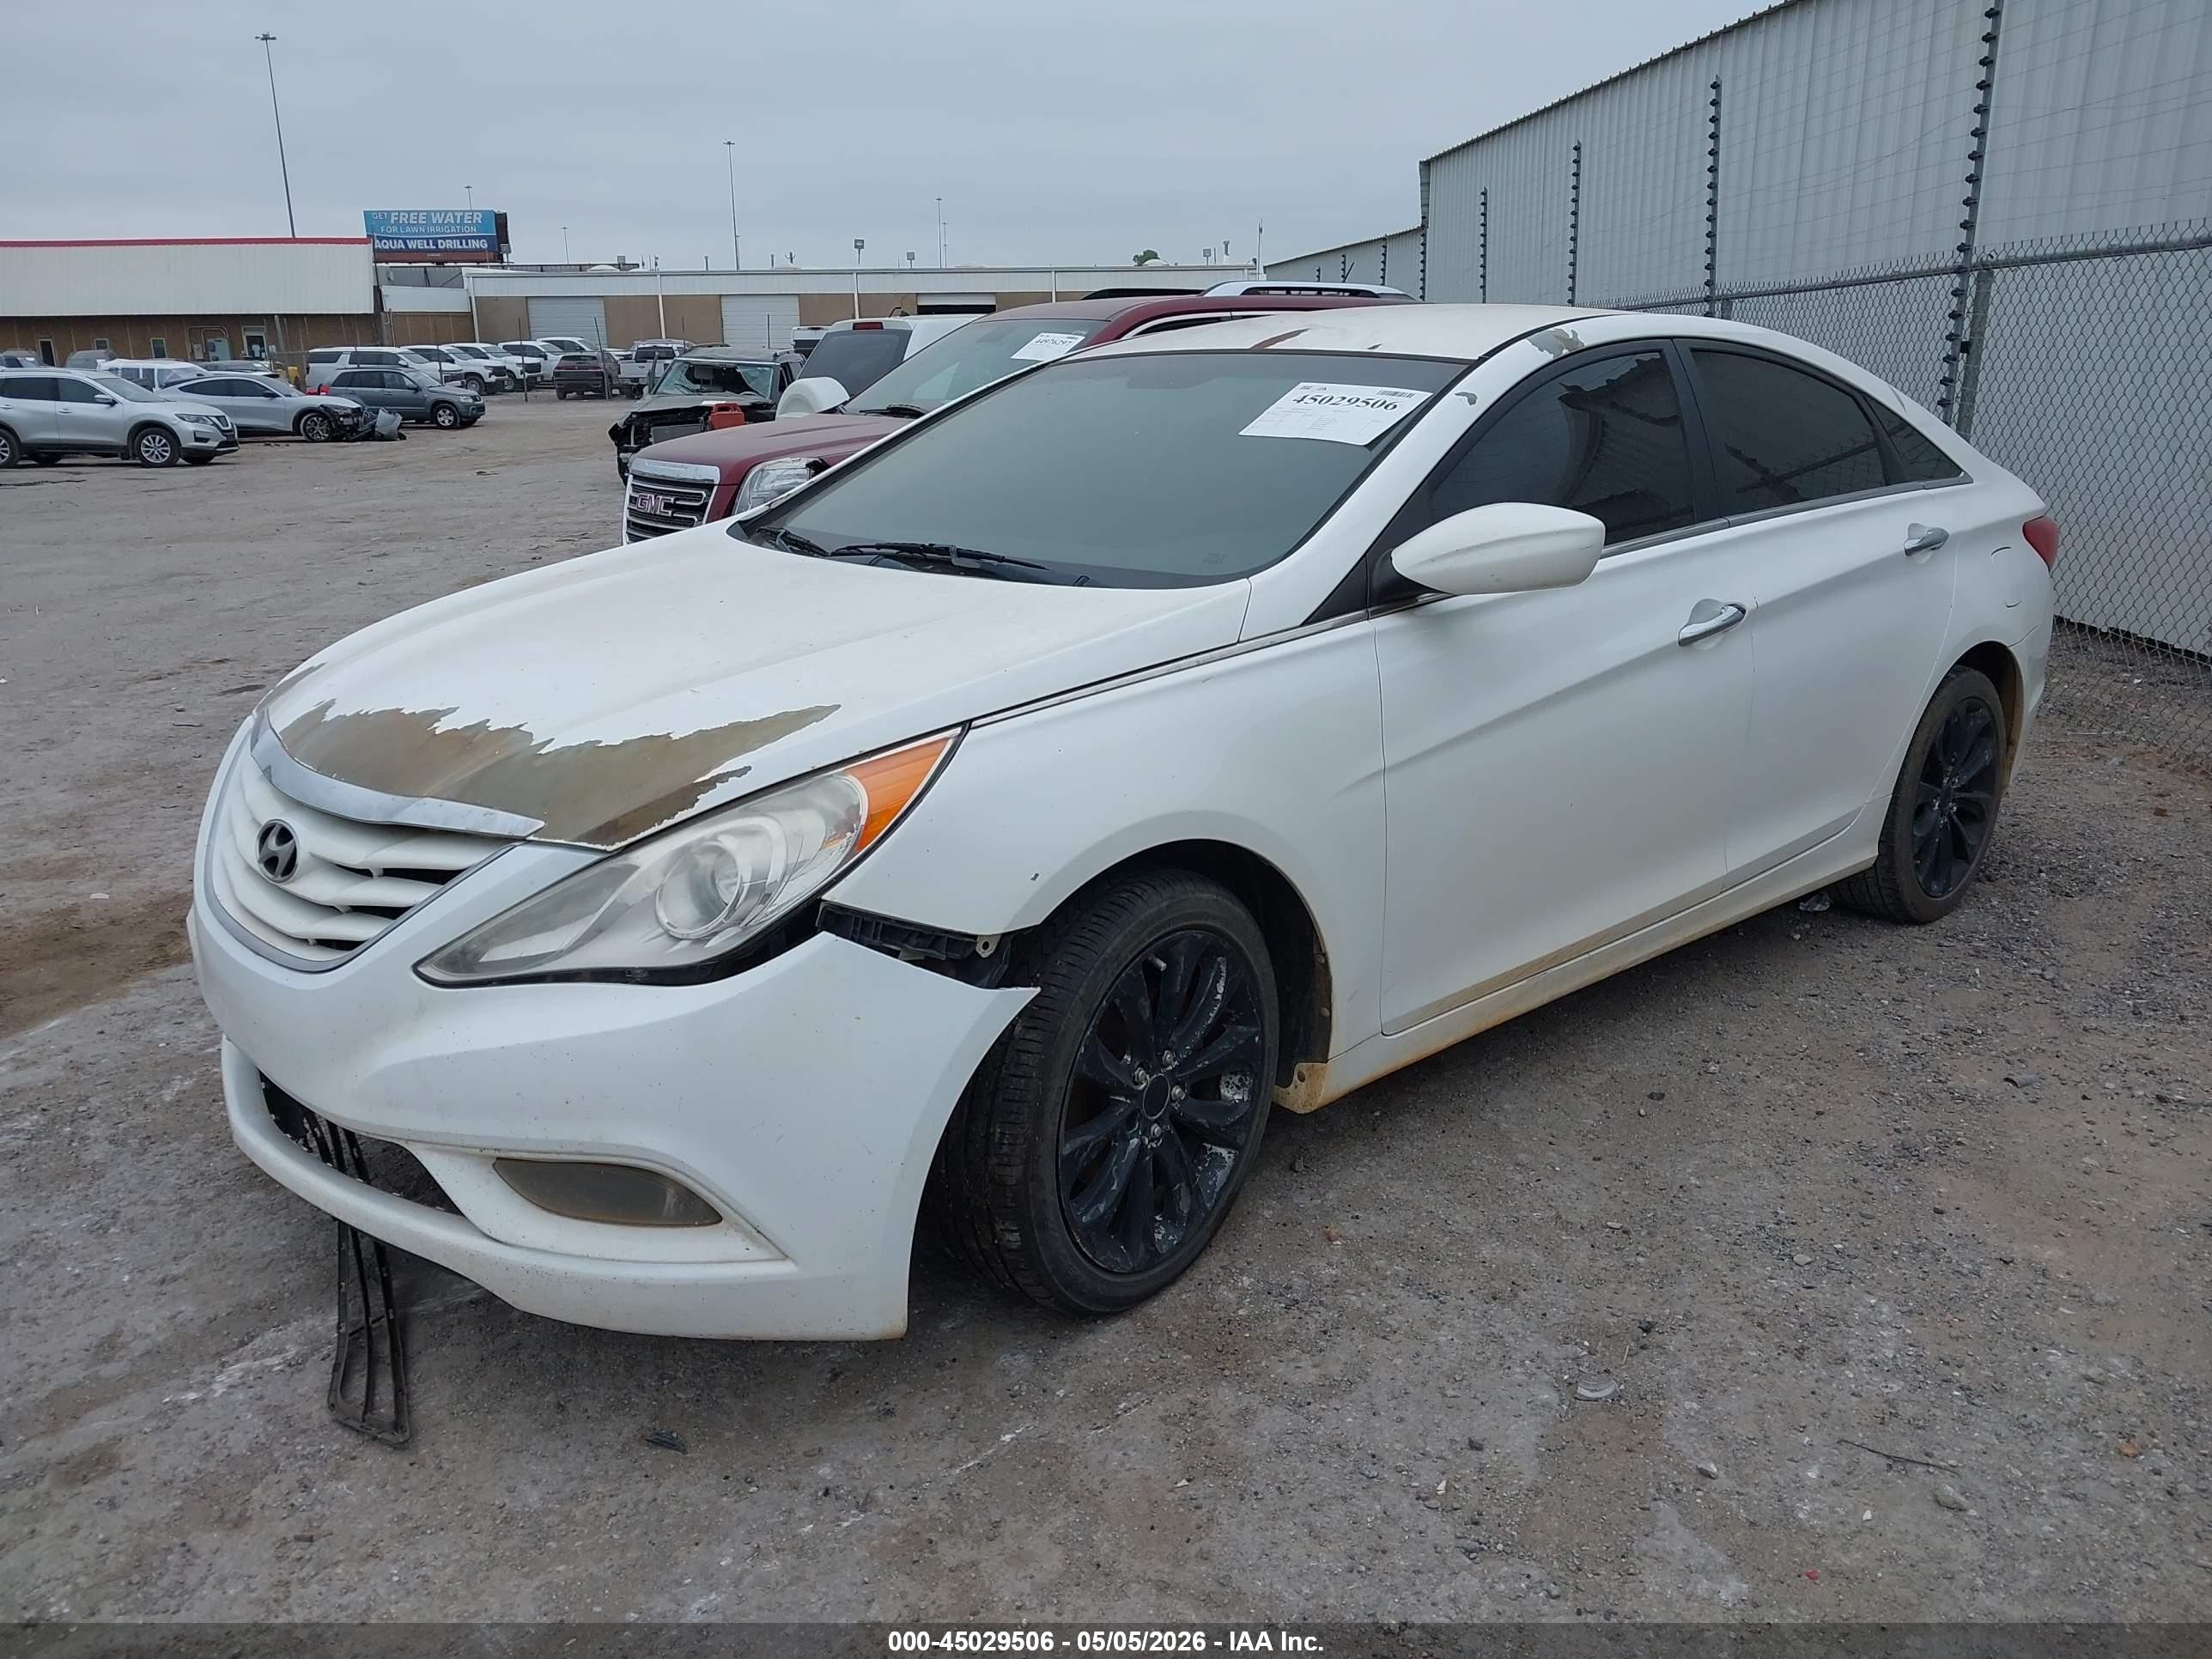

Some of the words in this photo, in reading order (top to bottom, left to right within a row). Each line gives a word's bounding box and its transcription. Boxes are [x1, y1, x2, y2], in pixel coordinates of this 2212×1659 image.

[390, 212, 427, 224] FREE
[431, 212, 483, 224] WATER
[374, 240, 406, 250] AQUA
[408, 240, 436, 249] WELL
[438, 240, 488, 249] DRILLING
[1291, 394, 1398, 410] 45029506
[637, 494, 675, 517] GMC
